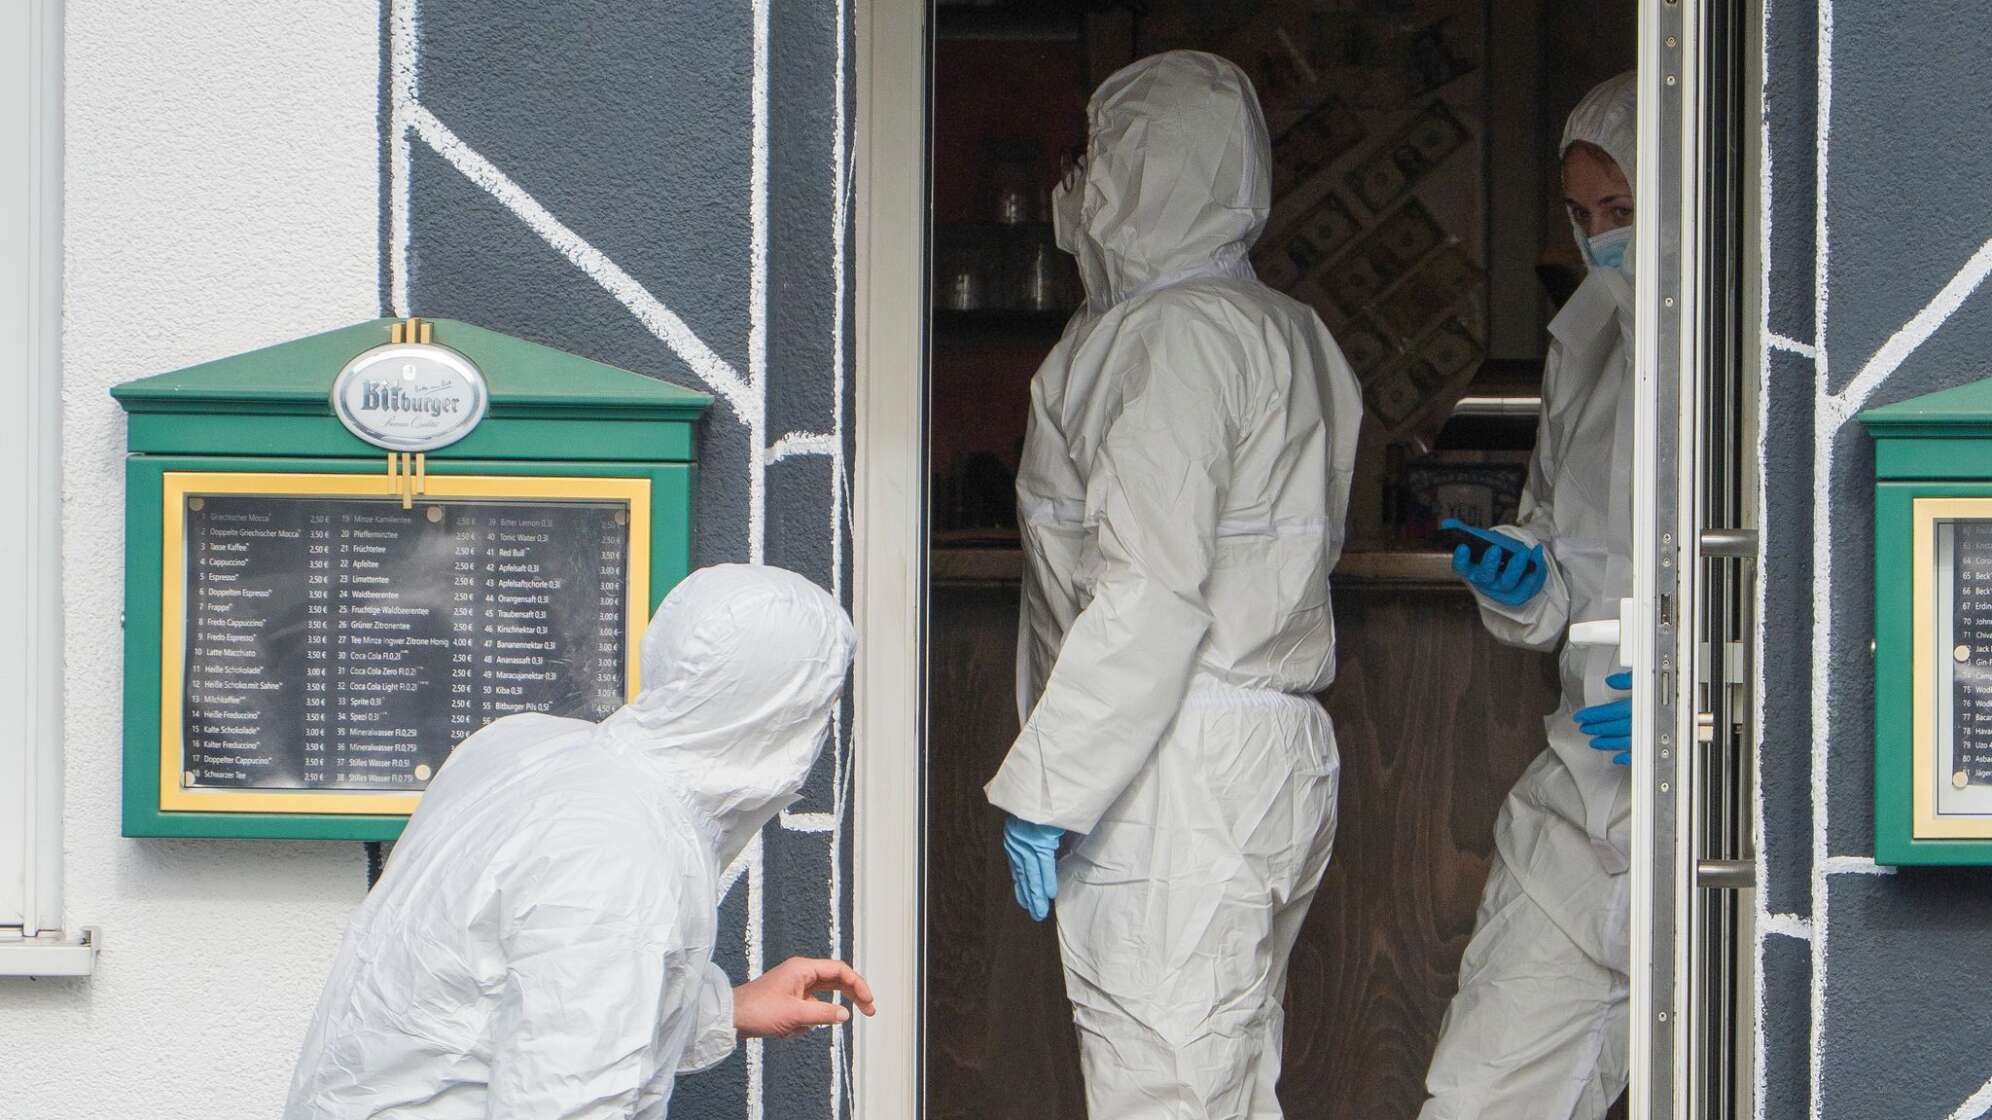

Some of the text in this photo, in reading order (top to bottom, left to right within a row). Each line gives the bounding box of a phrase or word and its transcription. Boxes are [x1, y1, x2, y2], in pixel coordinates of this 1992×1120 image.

[361, 379, 460, 417] Bitburger
[340, 545, 348, 553] 21
[486, 548, 494, 556] 41
[340, 560, 349, 568] 22
[486, 563, 495, 571] 42
[339, 575, 348, 583] 23
[485, 579, 495, 587] 43
[339, 590, 348, 598] 24
[1962, 602, 1971, 610] 67
[484, 609, 494, 617] 45
[338, 621, 347, 629] 26
[338, 636, 347, 644] 27
[194, 648, 202, 656] 10
[350, 652, 366, 660] Coca
[367, 652, 381, 661] Cola
[350, 667, 365, 675] Coca
[367, 667, 381, 675] Cola
[350, 682, 366, 691] Coca
[367, 682, 381, 691] Cola
